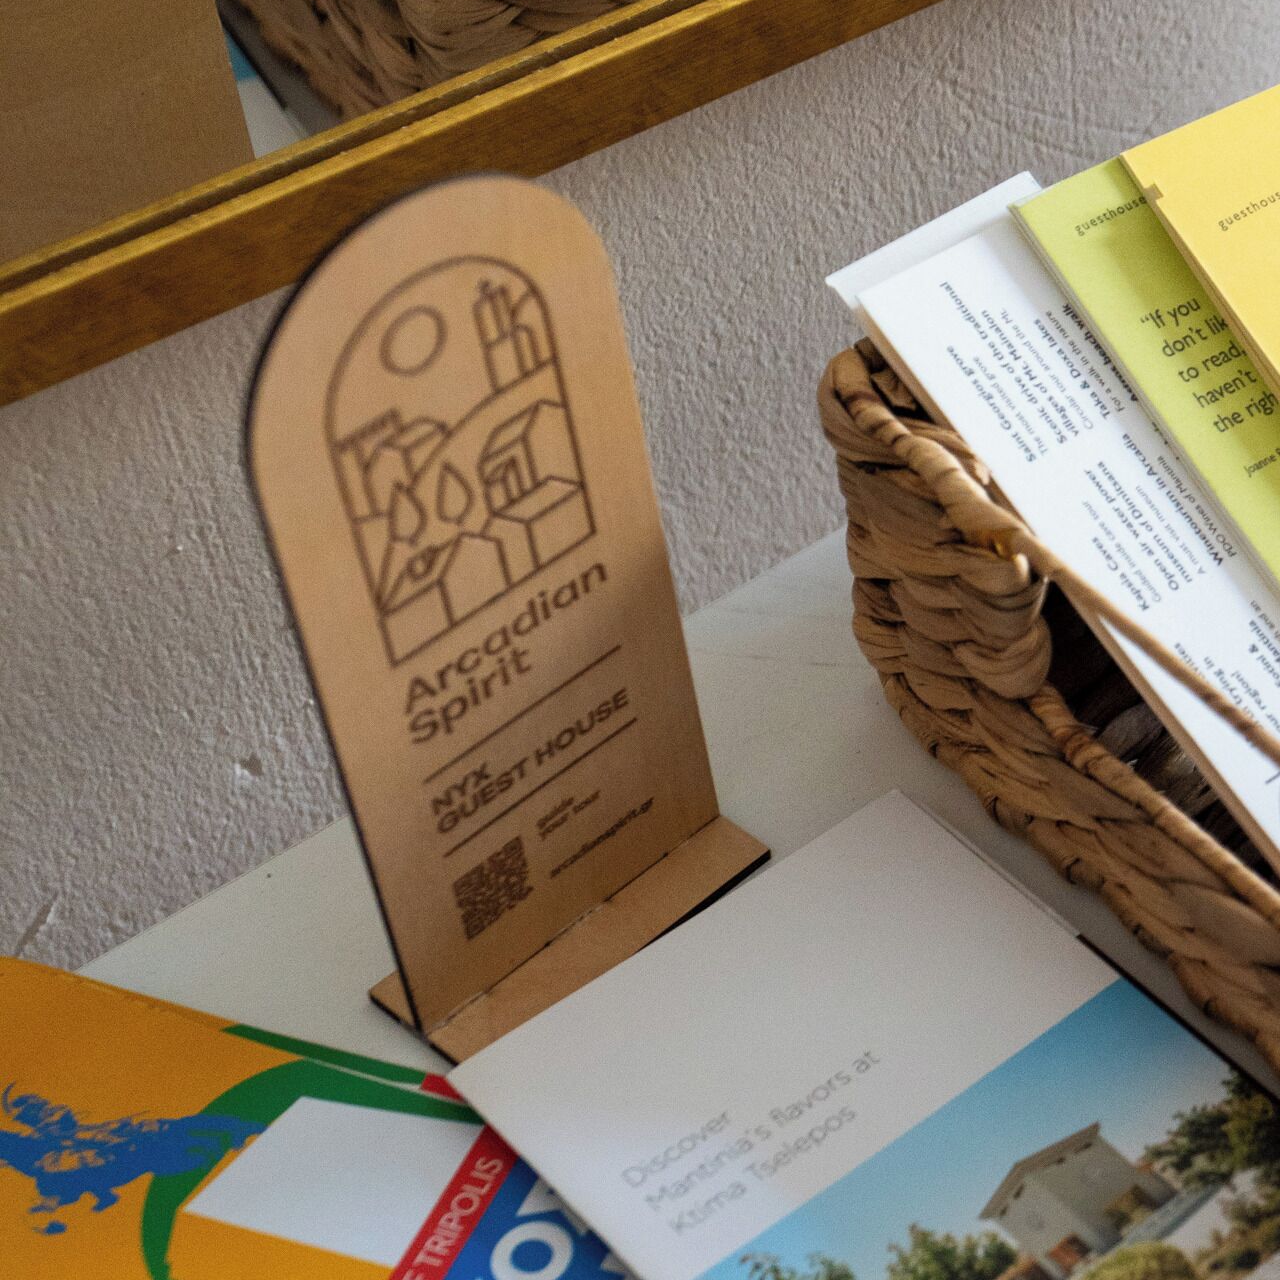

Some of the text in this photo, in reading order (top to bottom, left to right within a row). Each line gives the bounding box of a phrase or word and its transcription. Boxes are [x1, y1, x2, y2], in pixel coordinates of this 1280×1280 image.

[1075, 195, 1148, 236] guesthouse
[1045, 310, 1069, 339] nature
[1062, 302, 1086, 330] walk
[1170, 298, 1200, 320] you
[1207, 316, 1227, 336] lik
[939, 281, 1067, 444] Scenic drive of the traditional
[1067, 339, 1082, 355] the
[1080, 355, 1090, 366] in
[1084, 329, 1112, 365] beach
[1178, 341, 1247, 383] to read,
[981, 309, 1079, 436] villages of Mt. Mainalon
[1033, 318, 1110, 419] Taka & Doxa lakes
[1088, 365, 1105, 387] walk
[946, 346, 1036, 462] Saint Georgios grove
[1109, 396, 1125, 412] For
[1213, 390, 1279, 433] the righ
[1122, 433, 1158, 476] Arcadia
[1156, 455, 1187, 493] Mantinia
[1244, 453, 1277, 478] Joanne
[1155, 476, 1166, 490] in
[1182, 493, 1196, 503] of
[1084, 470, 1179, 591] Open air water power
[1097, 460, 1192, 583] museum of Dimitsana
[1165, 490, 1224, 566] Winetourism
[1194, 504, 1217, 534] Wines
[1215, 533, 1237, 557] PDO
[1091, 536, 1149, 611] Kapsia Caves
[1250, 600, 1261, 612] an
[1257, 612, 1275, 630] and
[405, 562, 609, 715] Arcadian
[1248, 643, 1259, 653] &
[409, 647, 532, 745] Spirit
[1203, 656, 1242, 705] trying in
[1230, 670, 1266, 710] region!
[437, 687, 630, 834] GUEST HOUSE
[432, 762, 492, 815] NYX
[770, 1072, 850, 1124] flavors
[854, 1052, 878, 1071] at
[622, 1111, 729, 1186] Discover
[670, 1106, 855, 1234] Ktima Tselepos
[416, 1155, 506, 1280] TRIPOLIS
